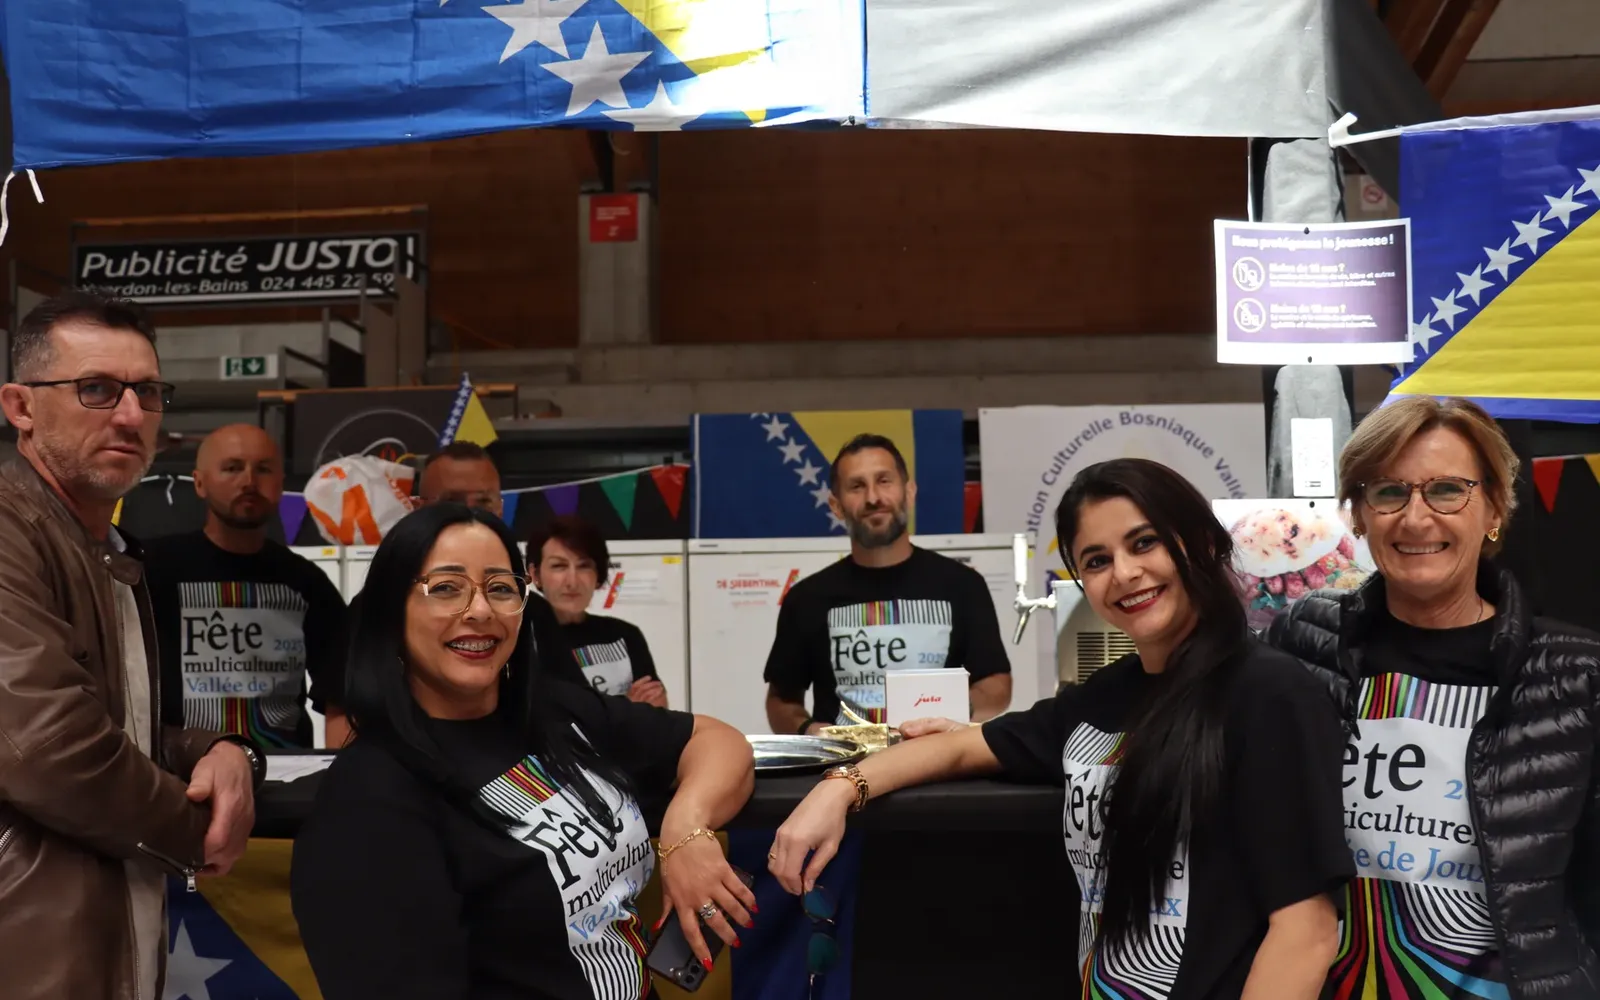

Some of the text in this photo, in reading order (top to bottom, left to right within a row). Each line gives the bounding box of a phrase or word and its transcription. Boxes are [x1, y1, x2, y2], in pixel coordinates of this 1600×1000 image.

[81, 246, 248, 278] Publicité
[81, 278, 249, 296] rdon-les-Bains
[261, 277, 295, 291] 024
[301, 274, 335, 289] 445
[1042, 419, 1114, 486] Culturelle
[1119, 411, 1215, 460] Bosniaque
[1214, 457, 1248, 499] Vallé
[183, 610, 263, 656] Fête
[184, 656, 304, 674] multiculturelle
[832, 629, 907, 672] Fête
[186, 676, 243, 693] Vallée
[247, 676, 268, 693] de
[838, 671, 886, 686] multic
[914, 693, 942, 707] jura
[1342, 727, 1426, 800] ête
[1377, 840, 1415, 873] de
[567, 838, 651, 918] multicultur
